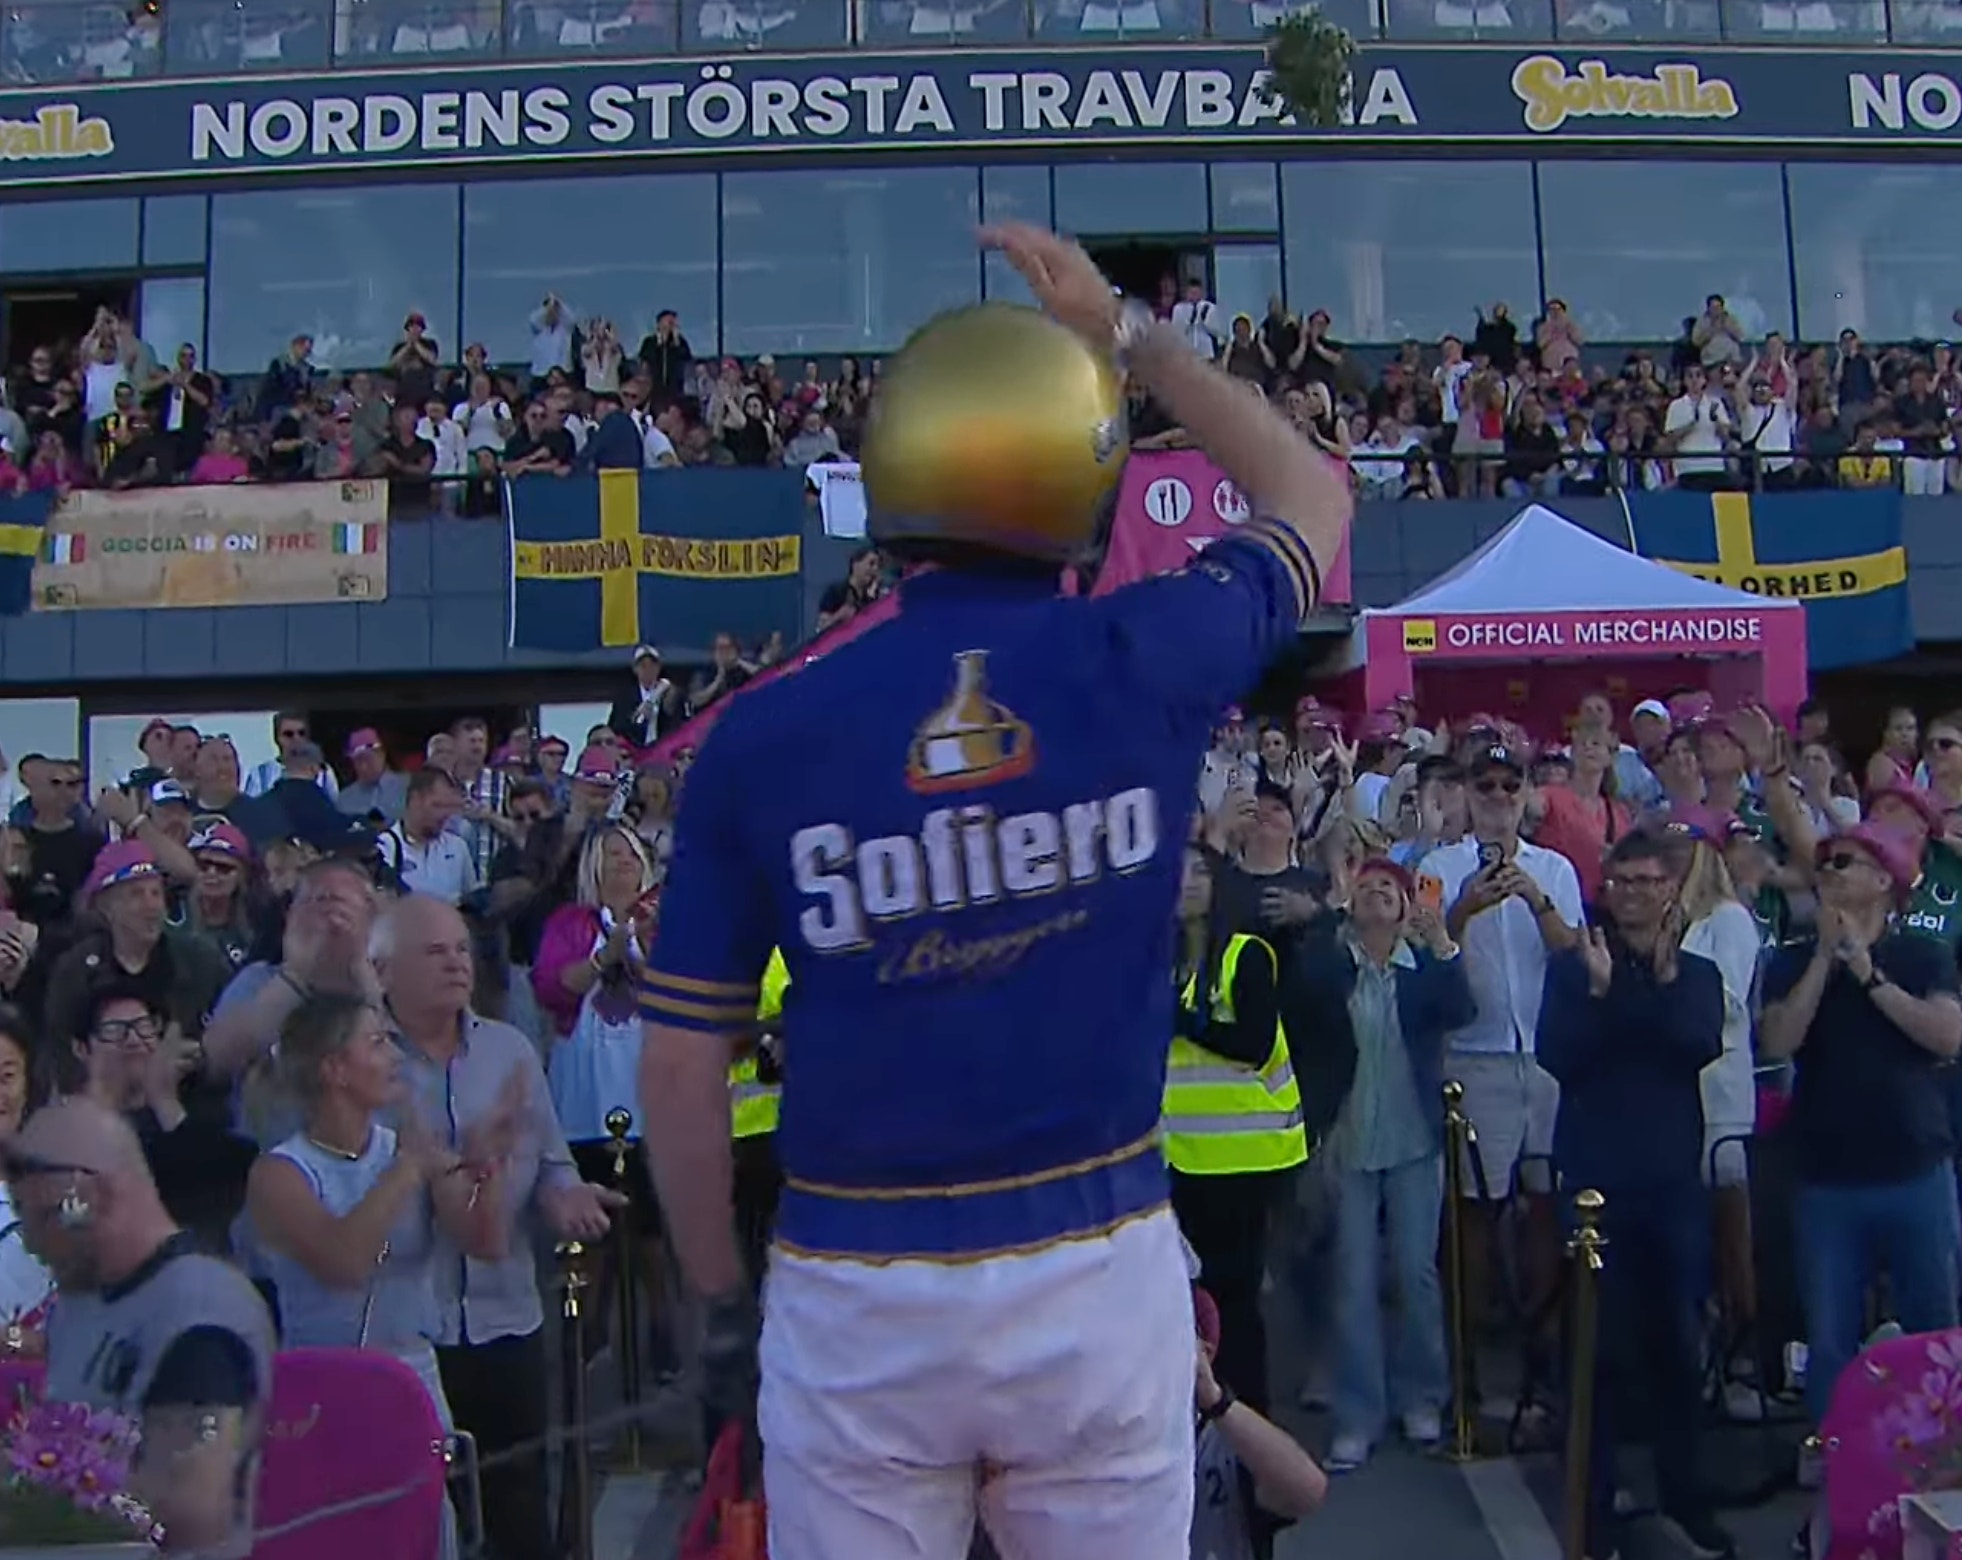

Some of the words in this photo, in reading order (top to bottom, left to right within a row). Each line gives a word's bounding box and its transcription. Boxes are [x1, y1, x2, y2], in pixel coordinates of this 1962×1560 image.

[191, 87, 571, 160] NORDENS
[588, 64, 955, 140] STÖRSTA
[970, 67, 1418, 131] TRAVBAA
[1512, 55, 1739, 131] Solvalla
[1848, 72, 1962, 130] NO
[101, 536, 187, 552] GOCCIA
[224, 533, 258, 552] ON
[266, 532, 316, 551] FIRE
[1448, 622, 1566, 647] OFFICIAL
[1574, 618, 1762, 644] MERCHANDISE
[790, 787, 1160, 955] Sofiero
